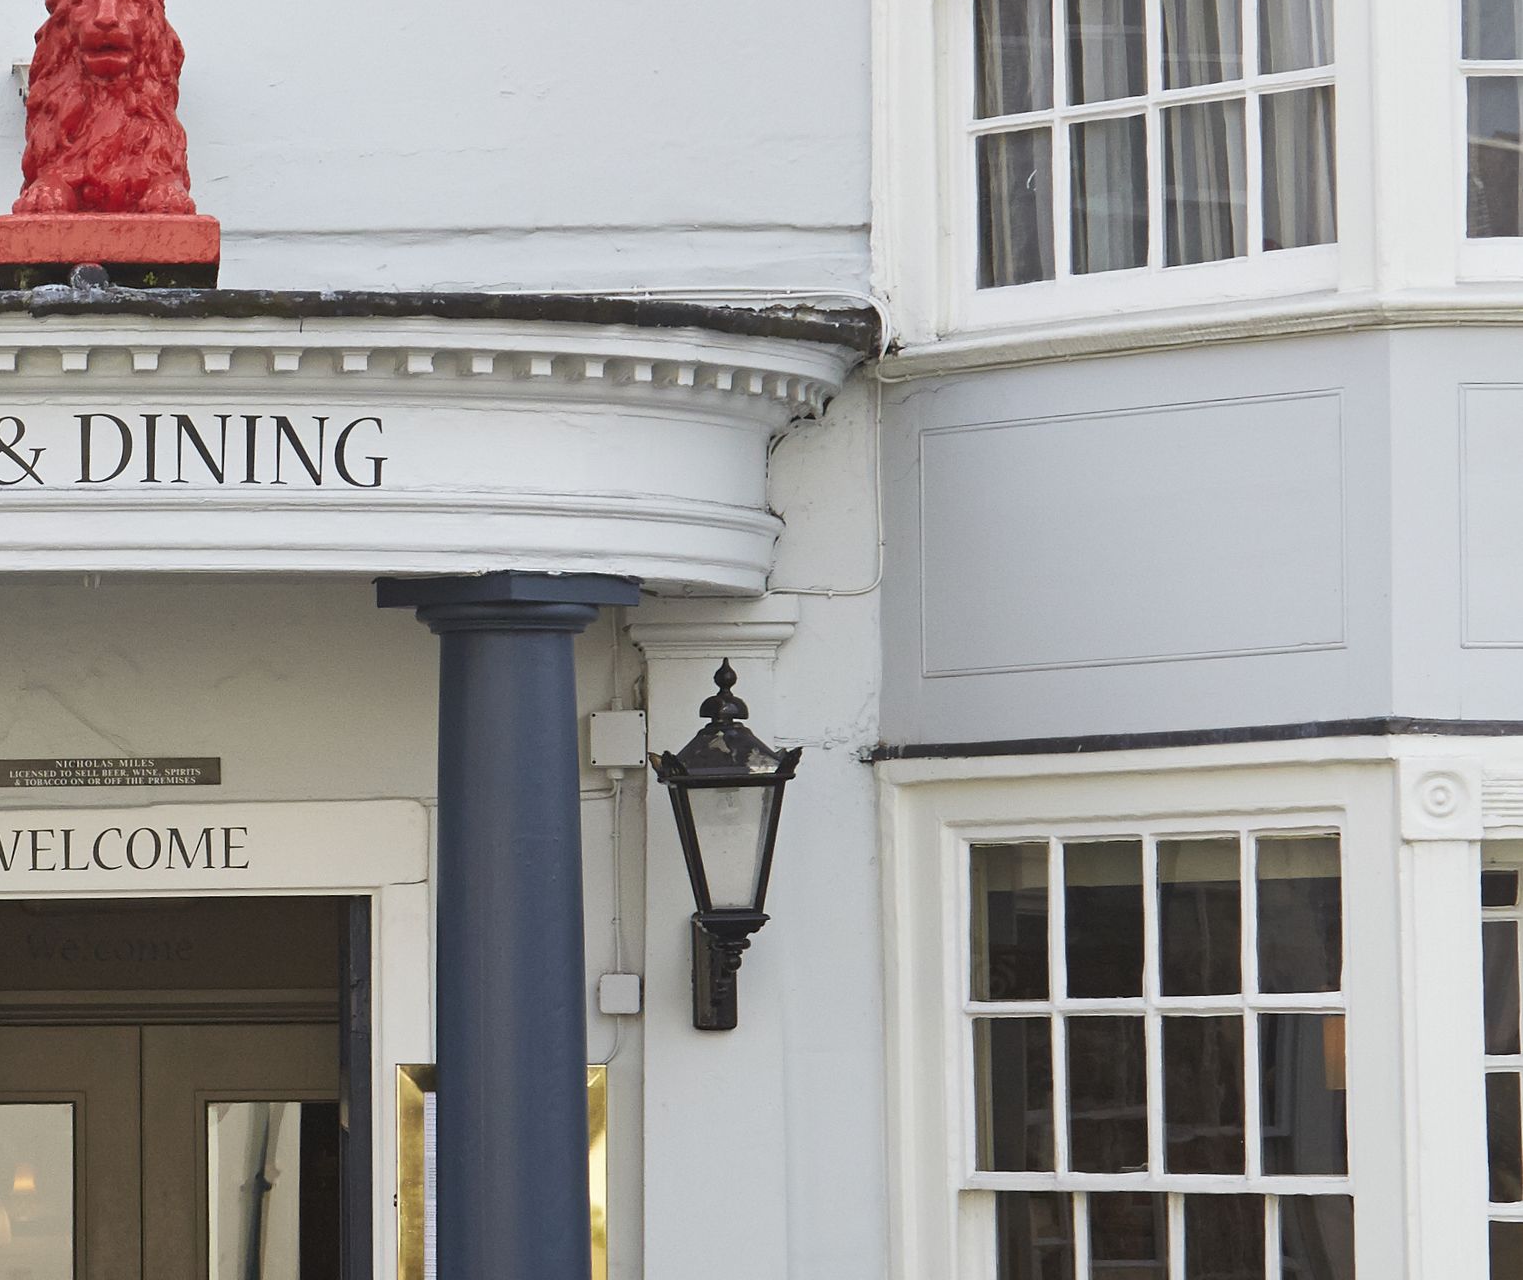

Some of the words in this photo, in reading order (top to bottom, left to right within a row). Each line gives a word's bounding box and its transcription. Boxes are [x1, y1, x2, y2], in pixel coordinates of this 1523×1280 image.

[74, 413, 388, 488] DINING
[55, 759, 114, 768] NICHOLAS
[119, 758, 155, 767] MILES
[9, 770, 57, 778] LICENSED
[60, 769, 72, 777] TO
[75, 769, 99, 777] SELL
[102, 768, 129, 777] BEER,
[132, 767, 162, 776] WINE,
[164, 767, 201, 776] SPIRITS
[25, 778, 68, 786] TOBACCO
[70, 778, 84, 786] ON
[87, 777, 101, 785] OR
[104, 777, 122, 785] OFF
[126, 776, 145, 784] THE
[148, 776, 196, 784] PREMISES
